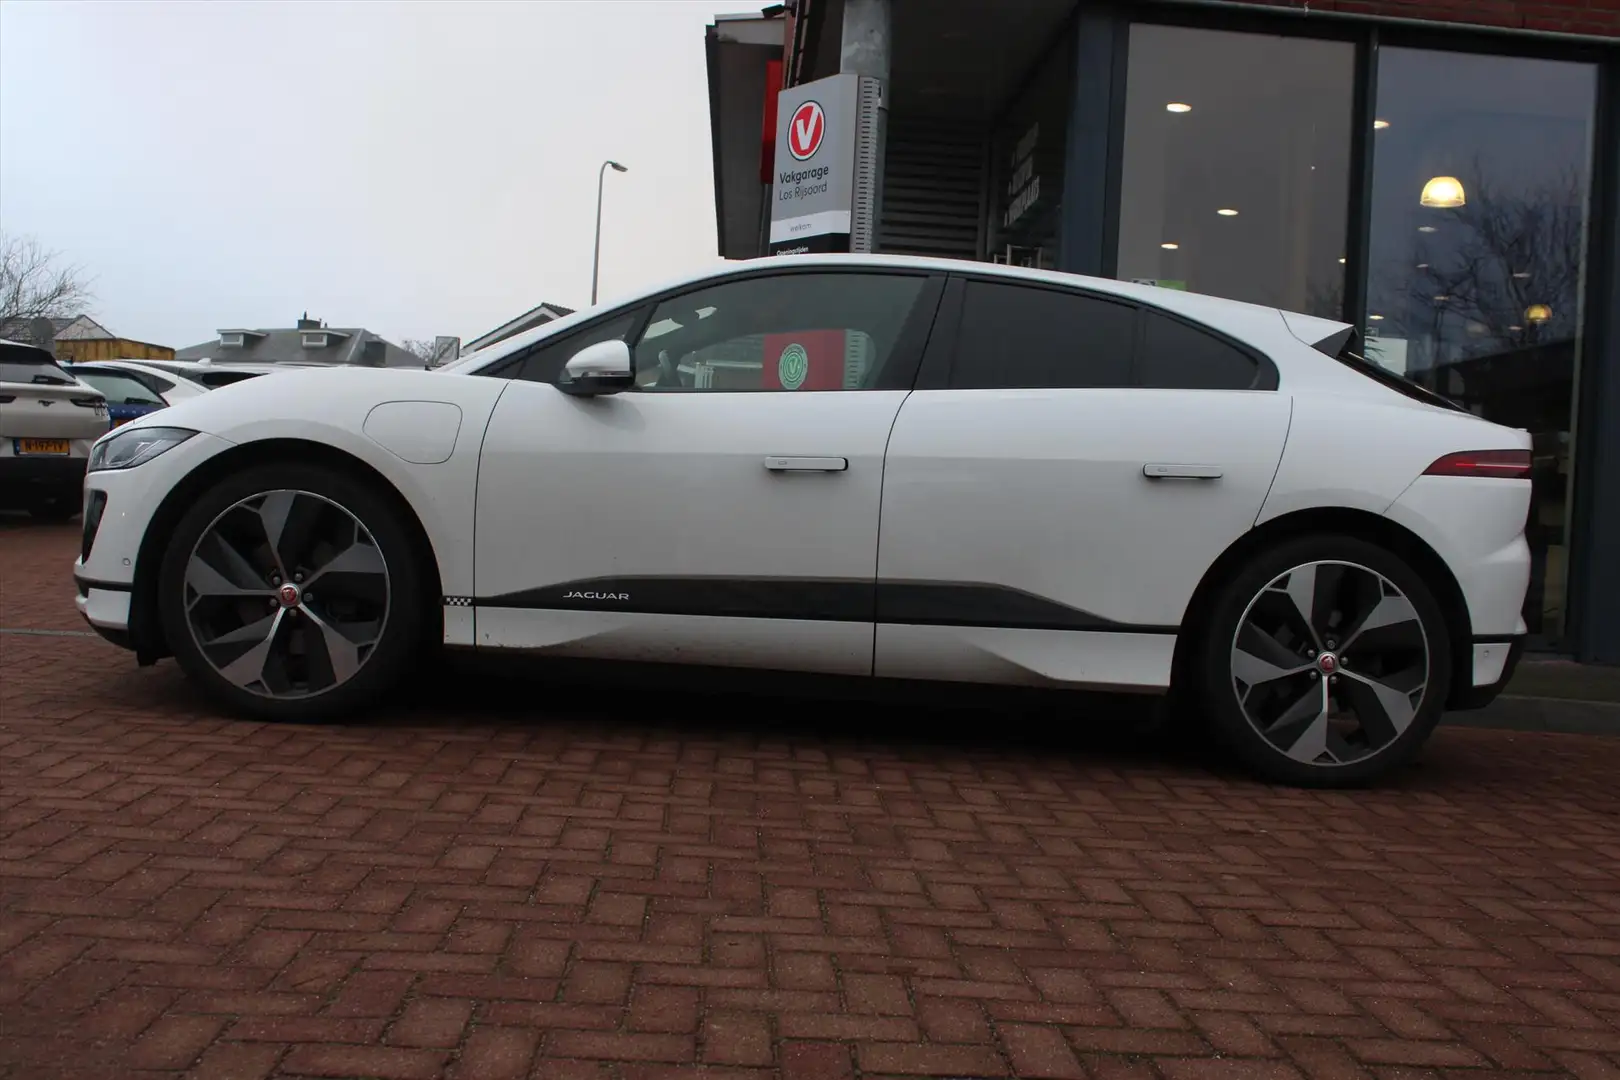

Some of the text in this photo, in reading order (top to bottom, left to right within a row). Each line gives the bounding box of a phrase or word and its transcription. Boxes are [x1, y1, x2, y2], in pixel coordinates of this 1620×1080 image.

[779, 166, 829, 185] Vakgarage
[779, 180, 828, 201] Los Rijsoord
[562, 591, 630, 600] JAGUAR
